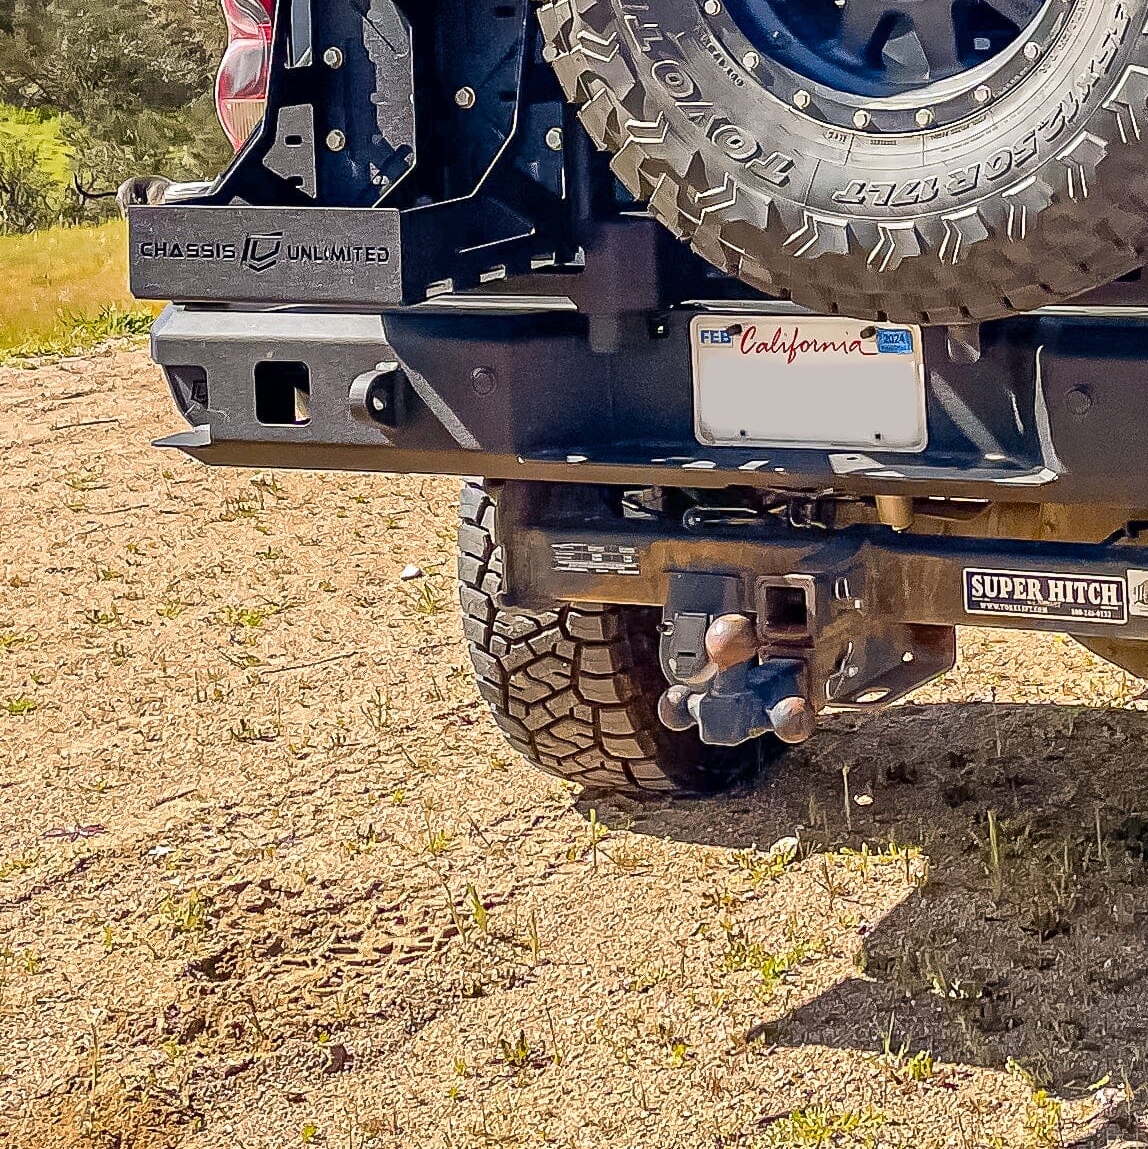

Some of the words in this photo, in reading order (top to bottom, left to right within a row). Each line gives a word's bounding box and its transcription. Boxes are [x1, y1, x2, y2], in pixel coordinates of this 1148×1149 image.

[651, 58, 796, 188] TOYO
[140, 242, 236, 260] CHASSIS
[287, 244, 390, 264] UNLIMITED
[700, 329, 732, 344] FEB
[740, 325, 879, 364] California
[883, 333, 906, 344] 2024
[971, 575, 1044, 603] SUPER
[1047, 579, 1123, 606] HITCH
